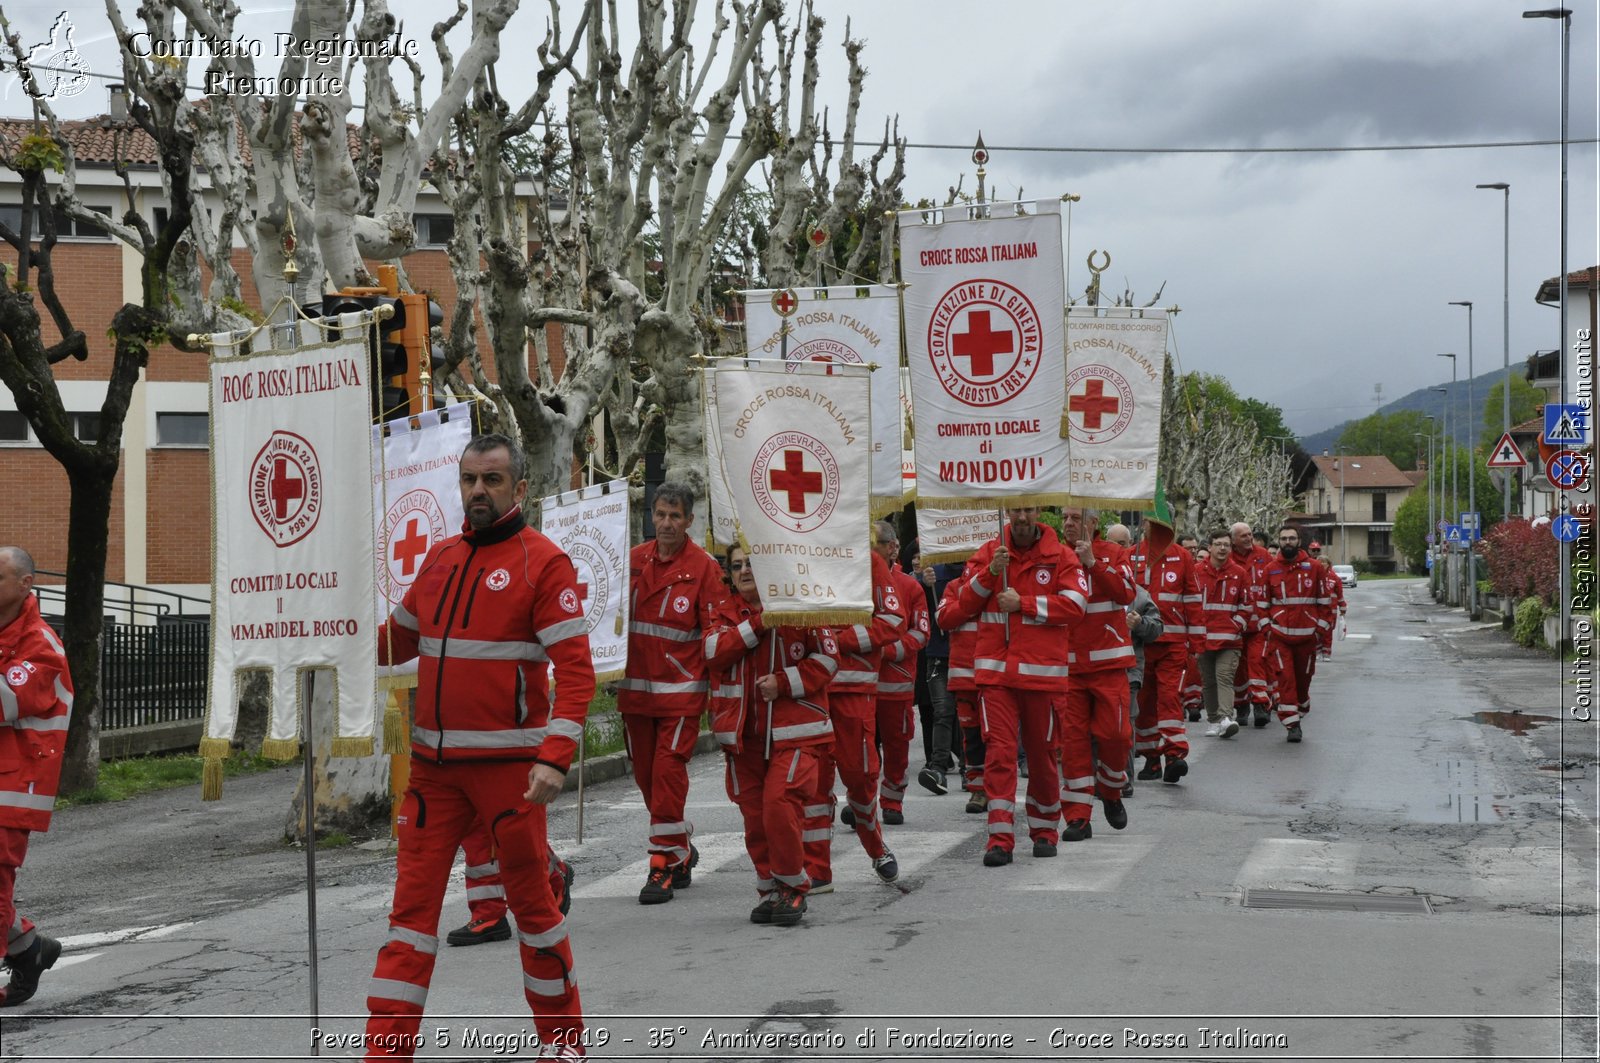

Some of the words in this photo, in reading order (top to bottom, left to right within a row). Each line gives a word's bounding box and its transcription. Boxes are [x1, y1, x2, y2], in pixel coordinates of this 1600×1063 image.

[920, 249, 953, 266] CROCE
[955, 246, 988, 264] ROSSA
[991, 242, 1038, 262] ITALIANA
[796, 312, 834, 327] ROSSA
[839, 315, 881, 348] ITALIANA
[932, 285, 984, 357] CONVENZIONE
[990, 286, 1005, 301] DI
[1007, 295, 1037, 352] GINEVRA
[1105, 323, 1119, 331] DEL
[1120, 323, 1162, 332] SOCCORSO
[804, 342, 843, 354] GINEVRA
[1073, 338, 1114, 351] ROSSA
[1116, 342, 1158, 381] ITALIANA
[944, 373, 959, 391] 22
[958, 384, 999, 402] AGOSTO
[1000, 369, 1027, 395] 1864
[1080, 367, 1114, 380] GINEVRA
[1121, 386, 1132, 420] AGOSTO
[734, 395, 766, 439] CROCE
[765, 386, 810, 402] ROSSA
[813, 392, 855, 445] ITALIANA
[937, 422, 991, 437] COMITATO
[995, 419, 1041, 435] LOCALE
[768, 441, 776, 451] DI
[776, 434, 814, 449] GINEVRA
[980, 440, 992, 454] di
[299, 450, 311, 465] 22
[814, 446, 826, 458] 22
[397, 464, 424, 479] ROSSA
[939, 457, 1043, 483] MONDOVI'
[1091, 459, 1133, 470] LOCALE
[1136, 461, 1148, 470] DI
[754, 447, 778, 517] CONVENZIONE
[824, 458, 837, 499] AGOSTO
[1071, 471, 1106, 483] BRA
[307, 466, 319, 513] AGOSTO
[388, 511, 400, 525] DI
[400, 494, 432, 515] GINEVRA
[818, 501, 832, 519] 1864
[288, 514, 310, 535] 1864
[935, 514, 981, 528] COMITATO
[982, 513, 1000, 523] LOC
[937, 534, 970, 545] LIMONE
[971, 531, 1000, 542] PIEMO
[590, 527, 622, 577] ITALIANA
[752, 544, 806, 555] OMITATO
[809, 545, 853, 558] LOCALE
[593, 561, 603, 574] 22
[797, 563, 809, 575] DI
[286, 572, 337, 589] LOCALE
[594, 577, 606, 616] AGOSTO
[768, 583, 836, 598] BUSCA
[280, 620, 309, 638] DEL
[313, 619, 358, 637] BOSCO
